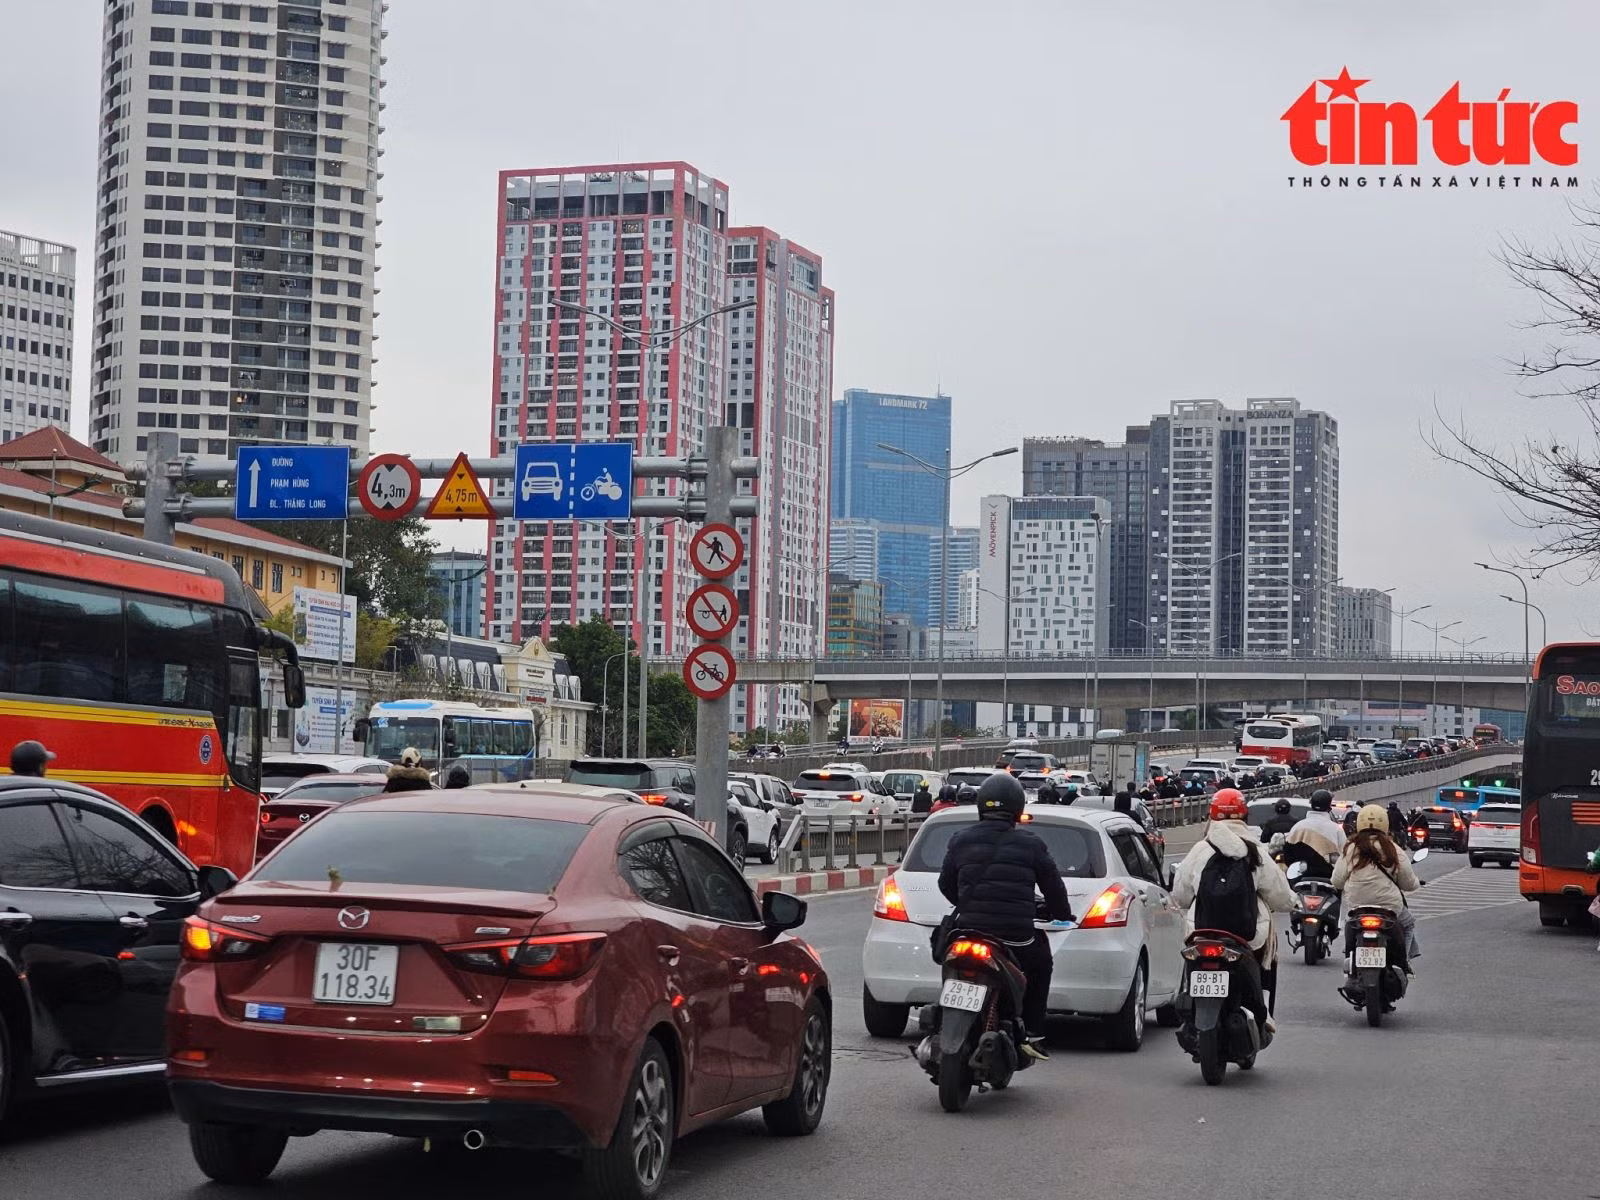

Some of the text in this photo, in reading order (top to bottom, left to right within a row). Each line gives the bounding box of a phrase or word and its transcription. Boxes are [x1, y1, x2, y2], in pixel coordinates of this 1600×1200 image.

[879, 397, 928, 410] LANDMARK 72
[1246, 409, 1294, 419] BONANZA
[271, 456, 294, 467] ĐƯỜNG
[292, 476, 310, 489] HÙNG
[371, 472, 406, 500] 4,3m
[309, 499, 327, 509] LONG
[336, 944, 380, 972] 30F
[1197, 973, 1223, 984] 89-B1
[321, 972, 391, 1001] 118.34
[950, 982, 980, 997] 29-P1
[1193, 984, 1226, 996] 880.35
[943, 993, 980, 1010] 680.28
